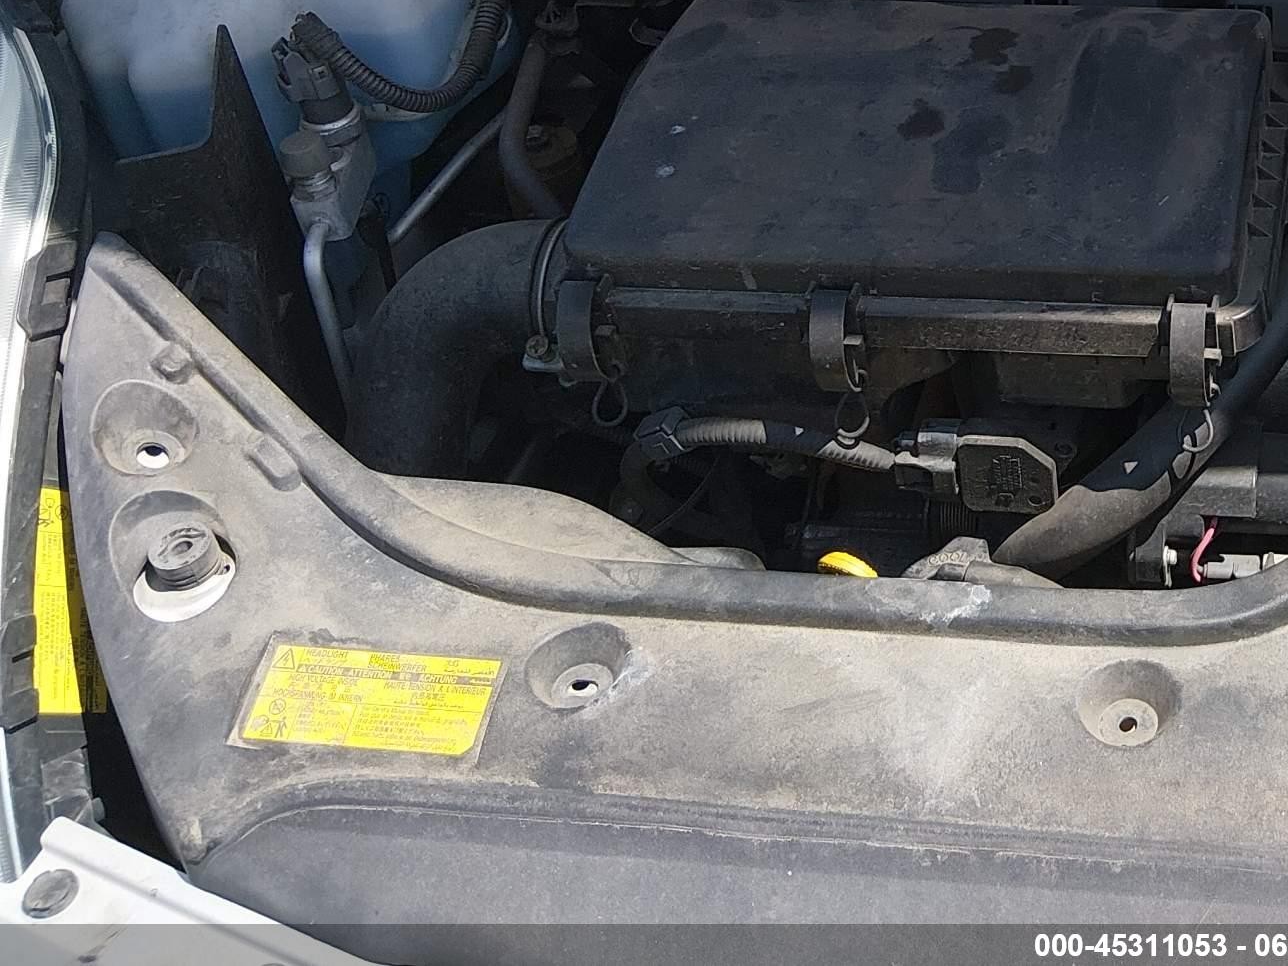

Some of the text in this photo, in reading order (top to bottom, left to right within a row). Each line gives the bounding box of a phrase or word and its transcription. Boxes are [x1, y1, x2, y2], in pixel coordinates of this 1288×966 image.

[306, 648, 350, 660] HEADLIGHT
[308, 664, 345, 677] CAUTION
[348, 668, 394, 681] ATTENTION
[418, 673, 460, 685] ACHTUNG
